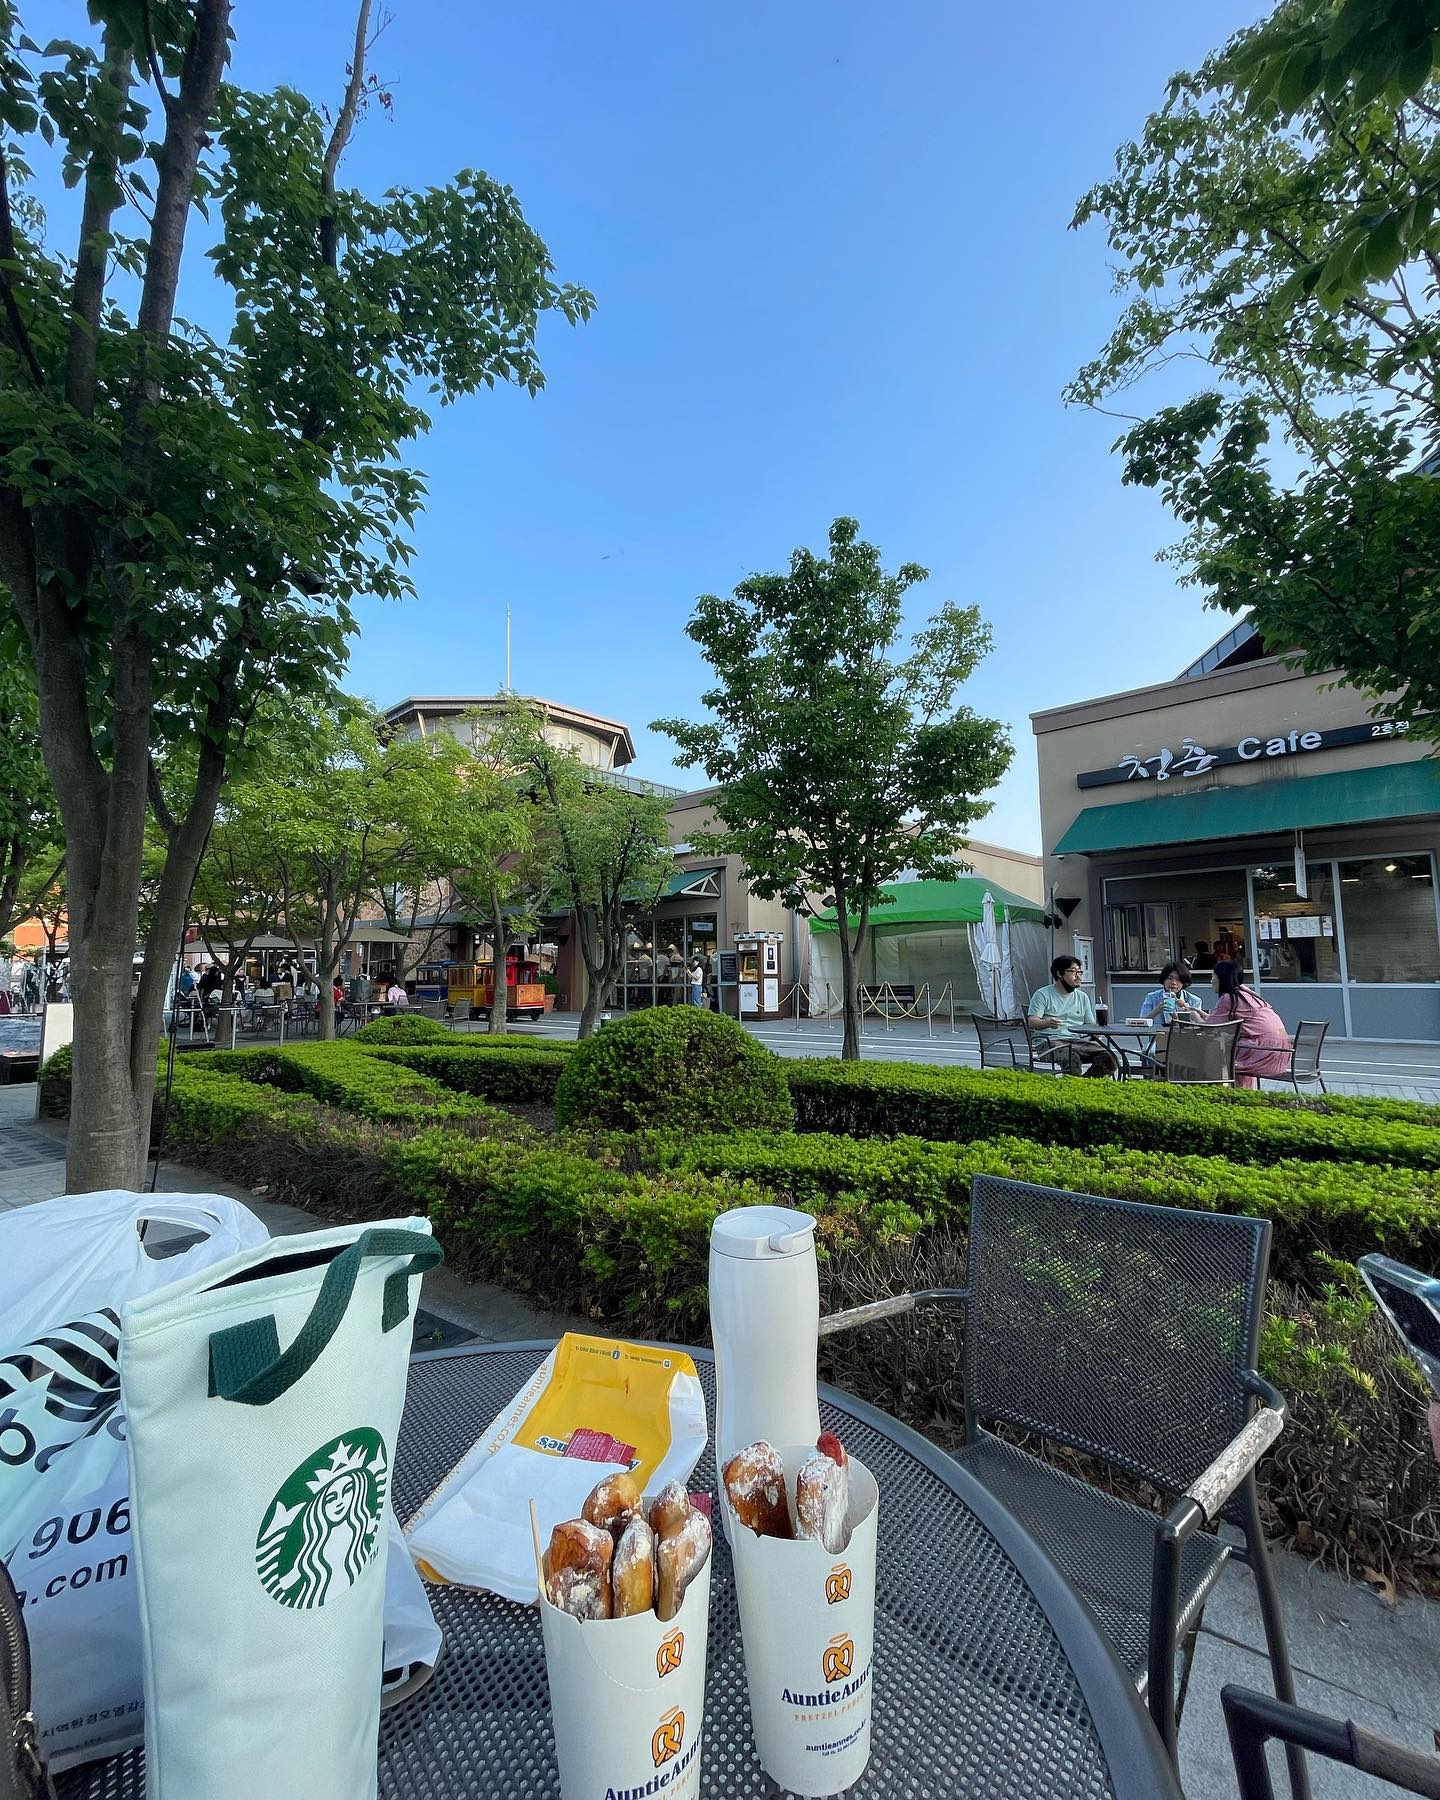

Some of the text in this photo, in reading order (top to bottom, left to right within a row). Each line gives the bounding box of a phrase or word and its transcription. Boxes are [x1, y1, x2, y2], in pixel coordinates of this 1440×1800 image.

[1118, 720, 1410, 781] 청춘 Cafe 2호점
[487, 1363, 548, 1457] auntieannes.co.kr
[781, 1688, 840, 1707] Auntie
